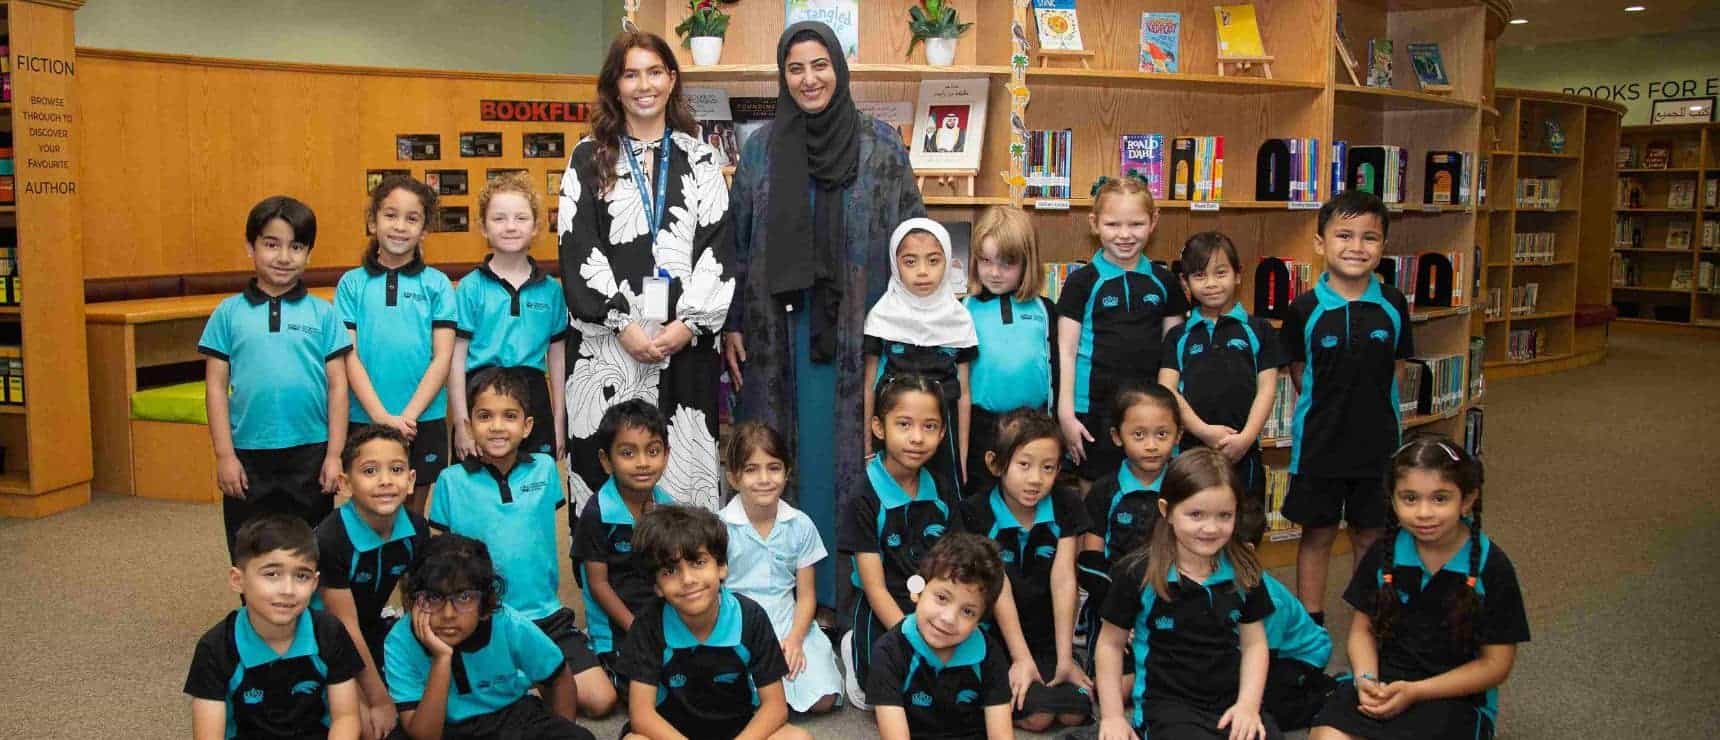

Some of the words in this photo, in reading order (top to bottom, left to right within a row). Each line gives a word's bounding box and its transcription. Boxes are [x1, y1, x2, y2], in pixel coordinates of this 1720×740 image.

[17, 55, 75, 76] FICTION
[1648, 80, 1697, 99] FOR
[31, 96, 65, 107] BROWSE
[23, 112, 62, 122] THROUGH
[29, 128, 69, 138] DISCOVER
[39, 144, 61, 153] YOUR
[1127, 139, 1158, 150] ROALD
[1128, 149, 1154, 160] DAHL
[25, 181, 76, 195] AUTHOR
